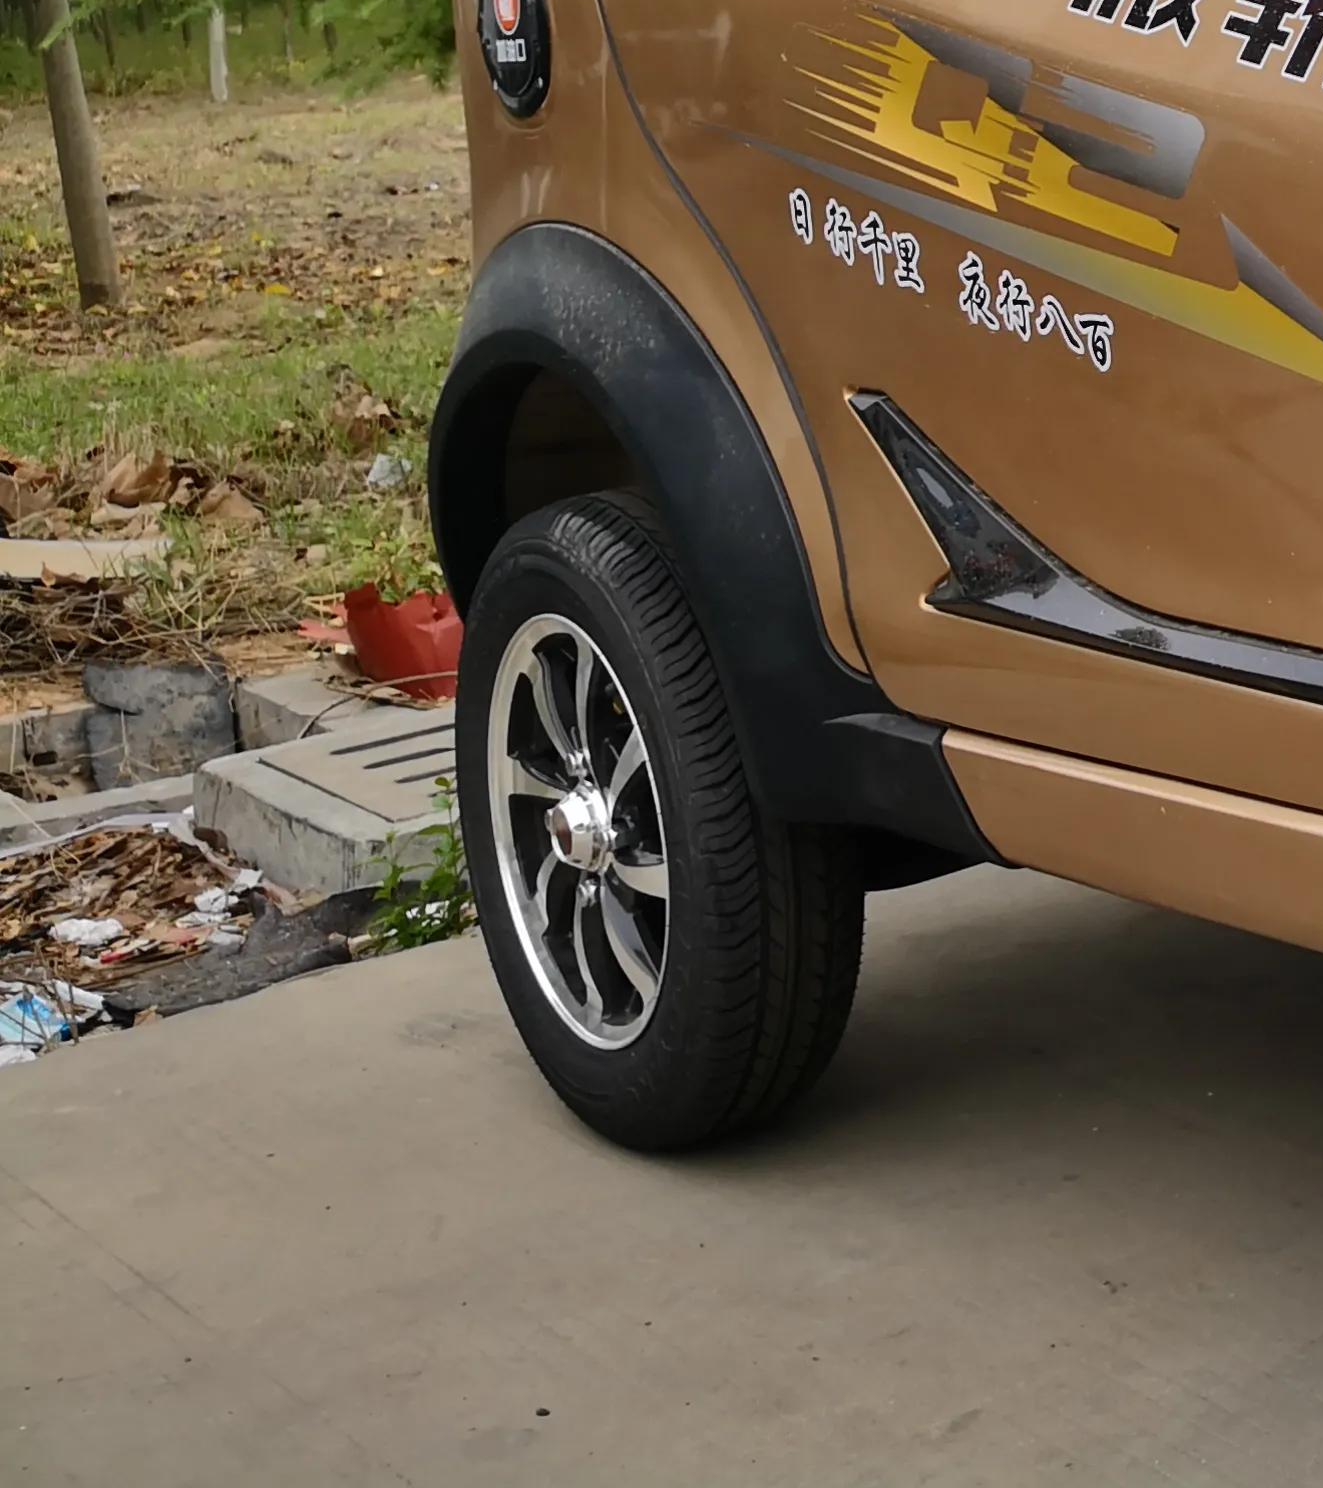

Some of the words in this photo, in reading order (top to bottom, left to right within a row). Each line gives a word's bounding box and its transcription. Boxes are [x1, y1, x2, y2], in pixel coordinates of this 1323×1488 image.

[789, 187, 925, 293] 日行千里
[958, 250, 1114, 373] 夜行八百
